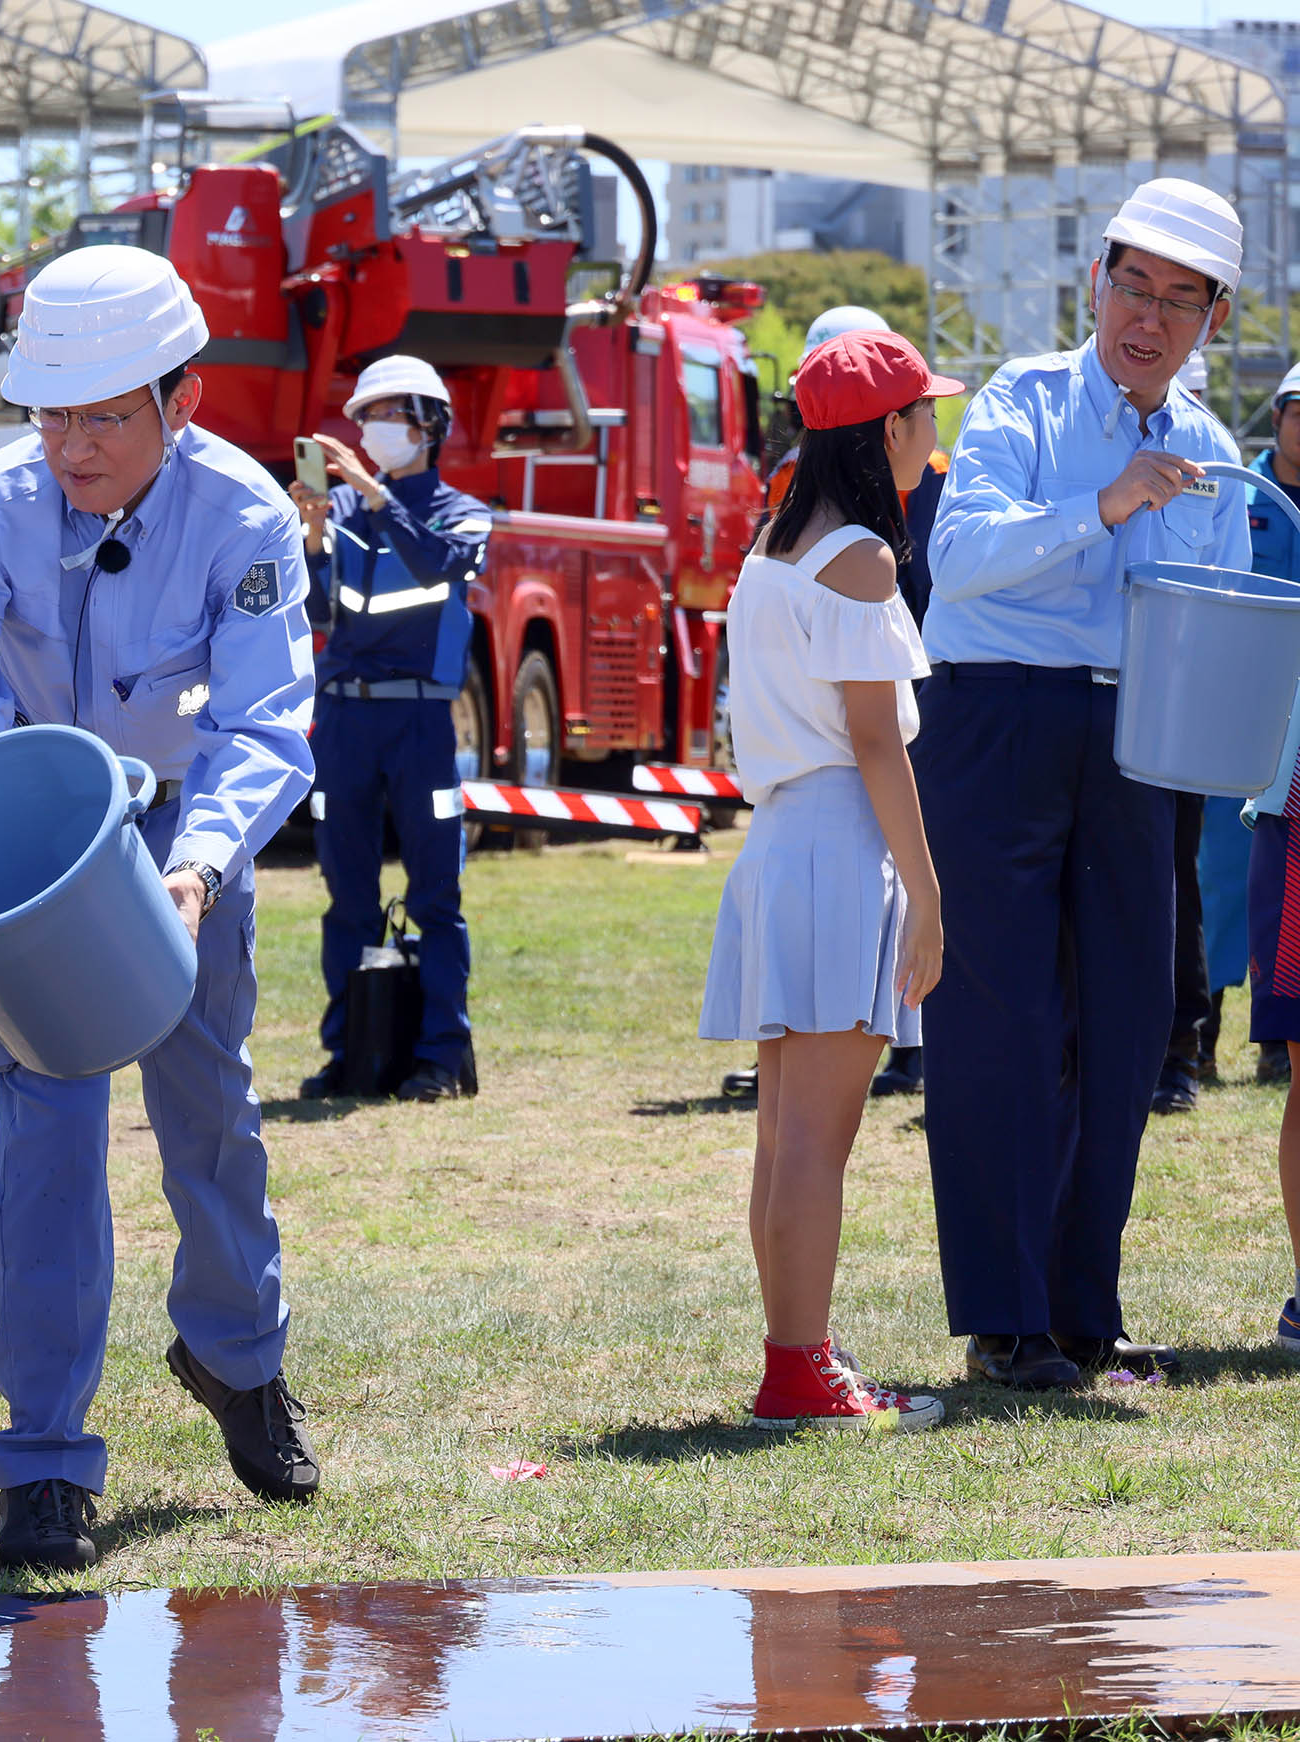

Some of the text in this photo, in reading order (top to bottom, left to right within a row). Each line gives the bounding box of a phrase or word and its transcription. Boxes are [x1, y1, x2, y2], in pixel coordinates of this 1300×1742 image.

[1187, 481, 1215, 493] 務大臣
[244, 595, 270, 607] 内閣
